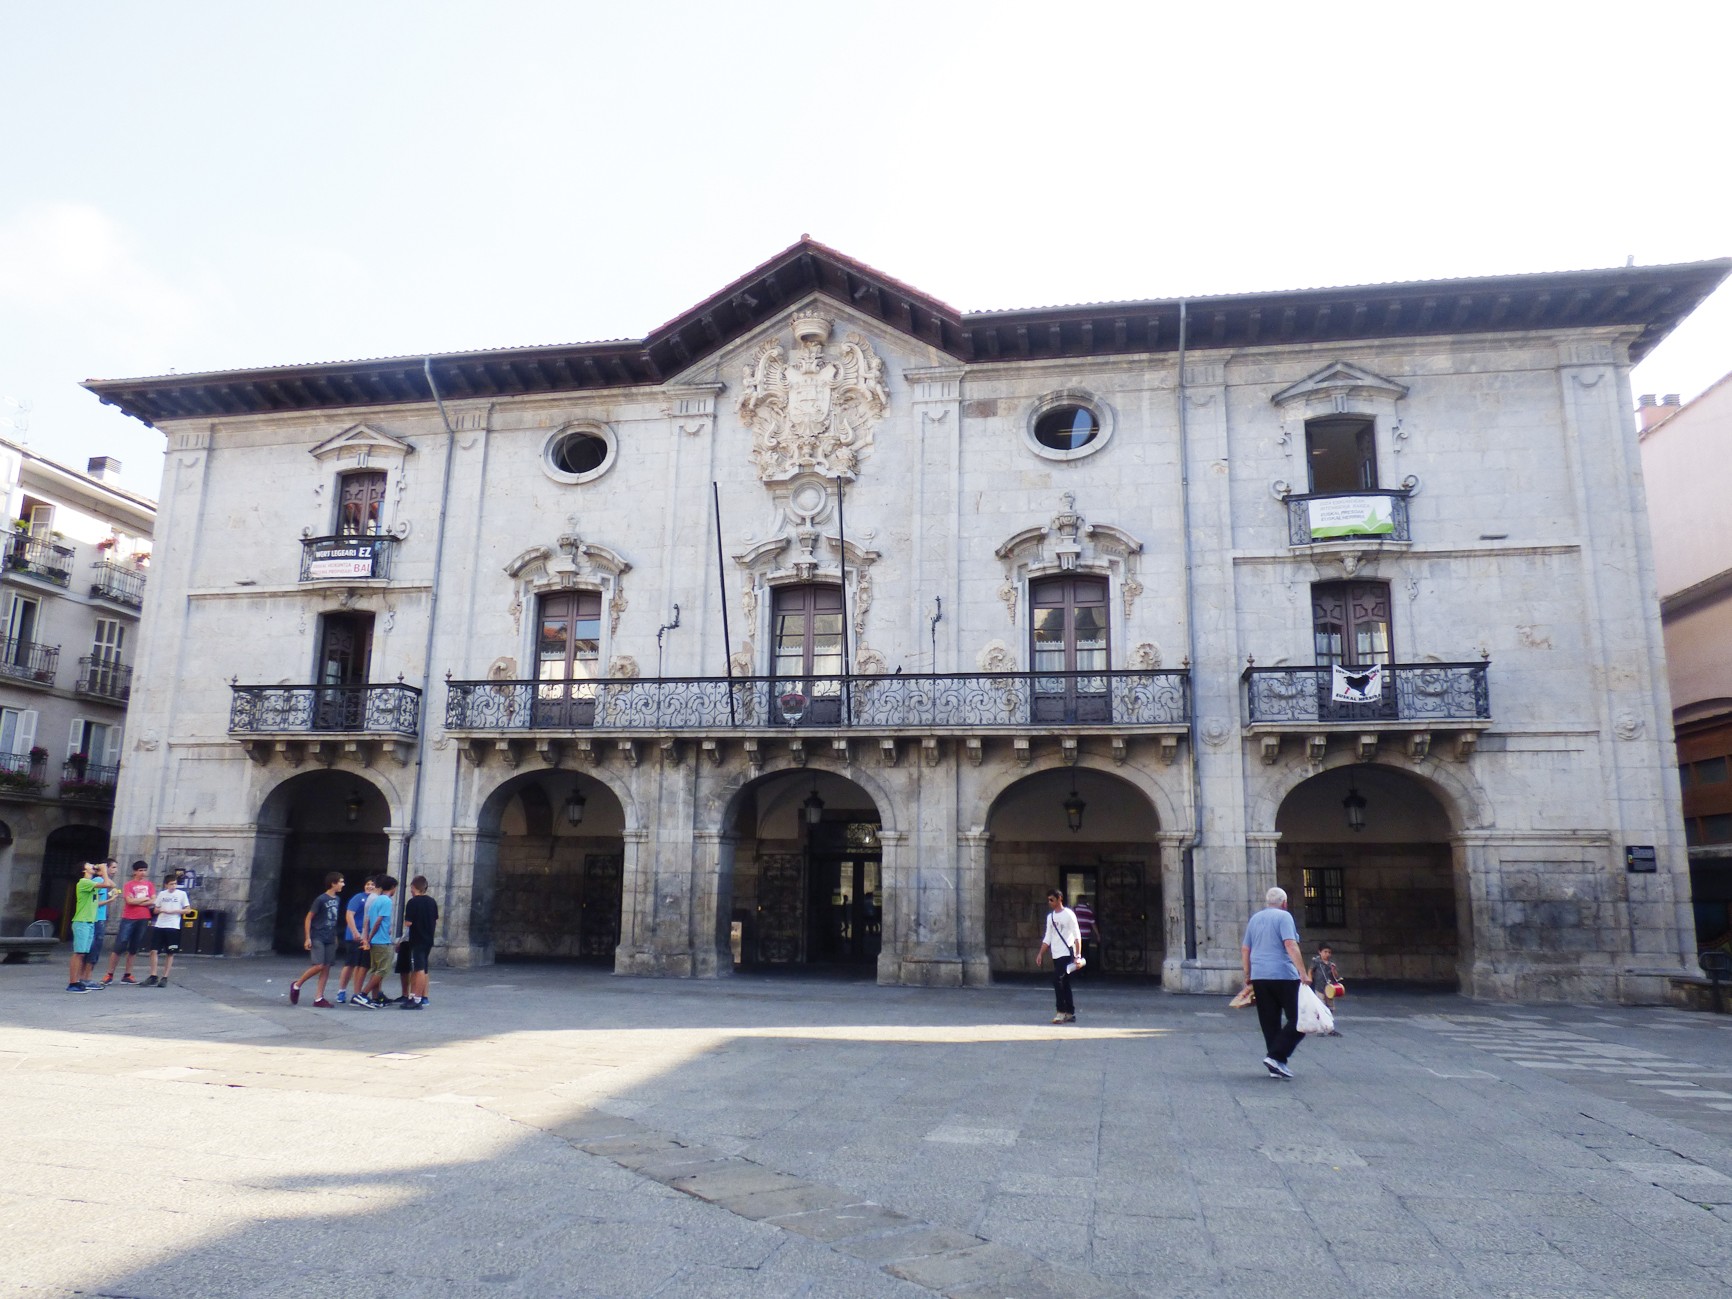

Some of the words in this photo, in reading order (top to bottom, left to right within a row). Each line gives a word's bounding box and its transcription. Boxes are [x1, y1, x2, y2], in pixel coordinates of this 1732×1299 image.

[331, 549, 357, 557] LEGEARI
[358, 547, 372, 558] EZ
[353, 563, 370, 573] BAI
